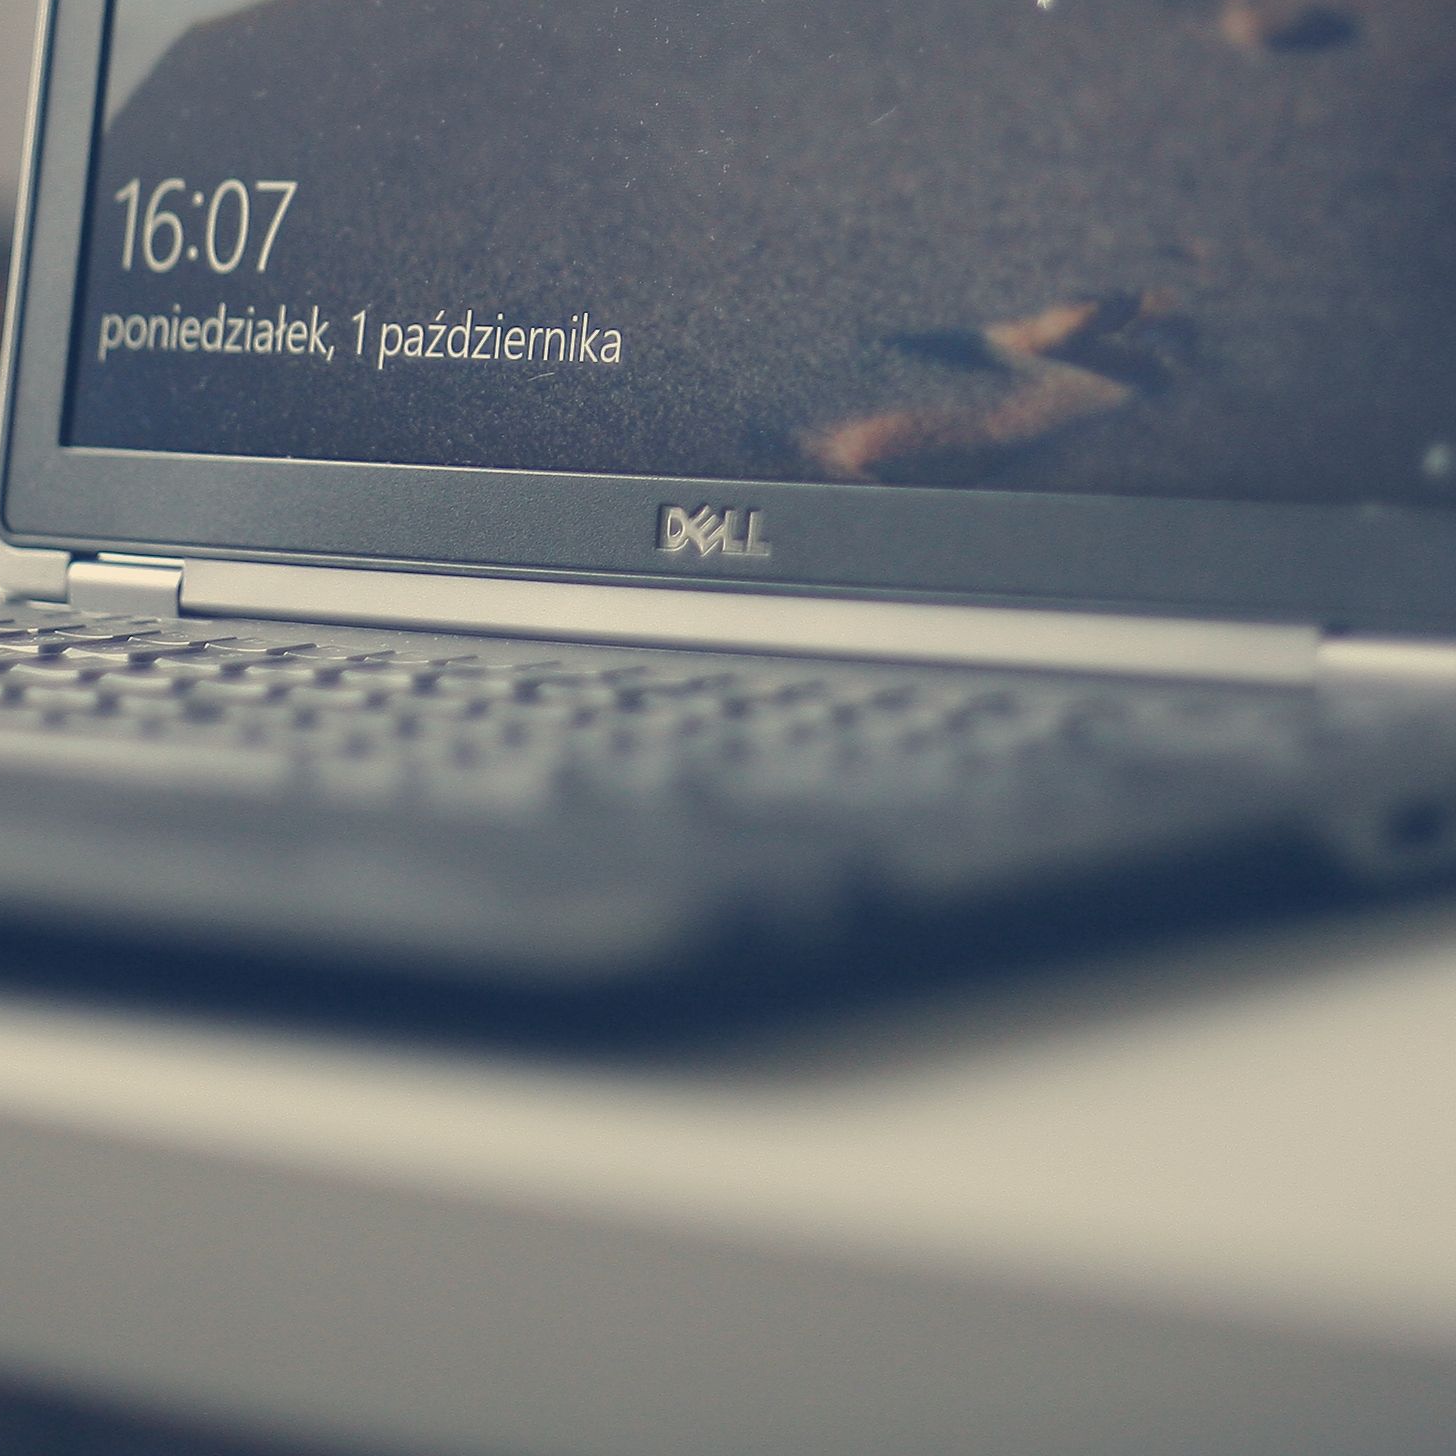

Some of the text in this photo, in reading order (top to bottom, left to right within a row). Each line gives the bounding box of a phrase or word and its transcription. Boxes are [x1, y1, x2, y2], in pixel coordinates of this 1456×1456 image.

[114, 177, 298, 275] 16:07
[98, 302, 623, 370] poniedziałek, 1 października
[656, 504, 772, 557] DELL
